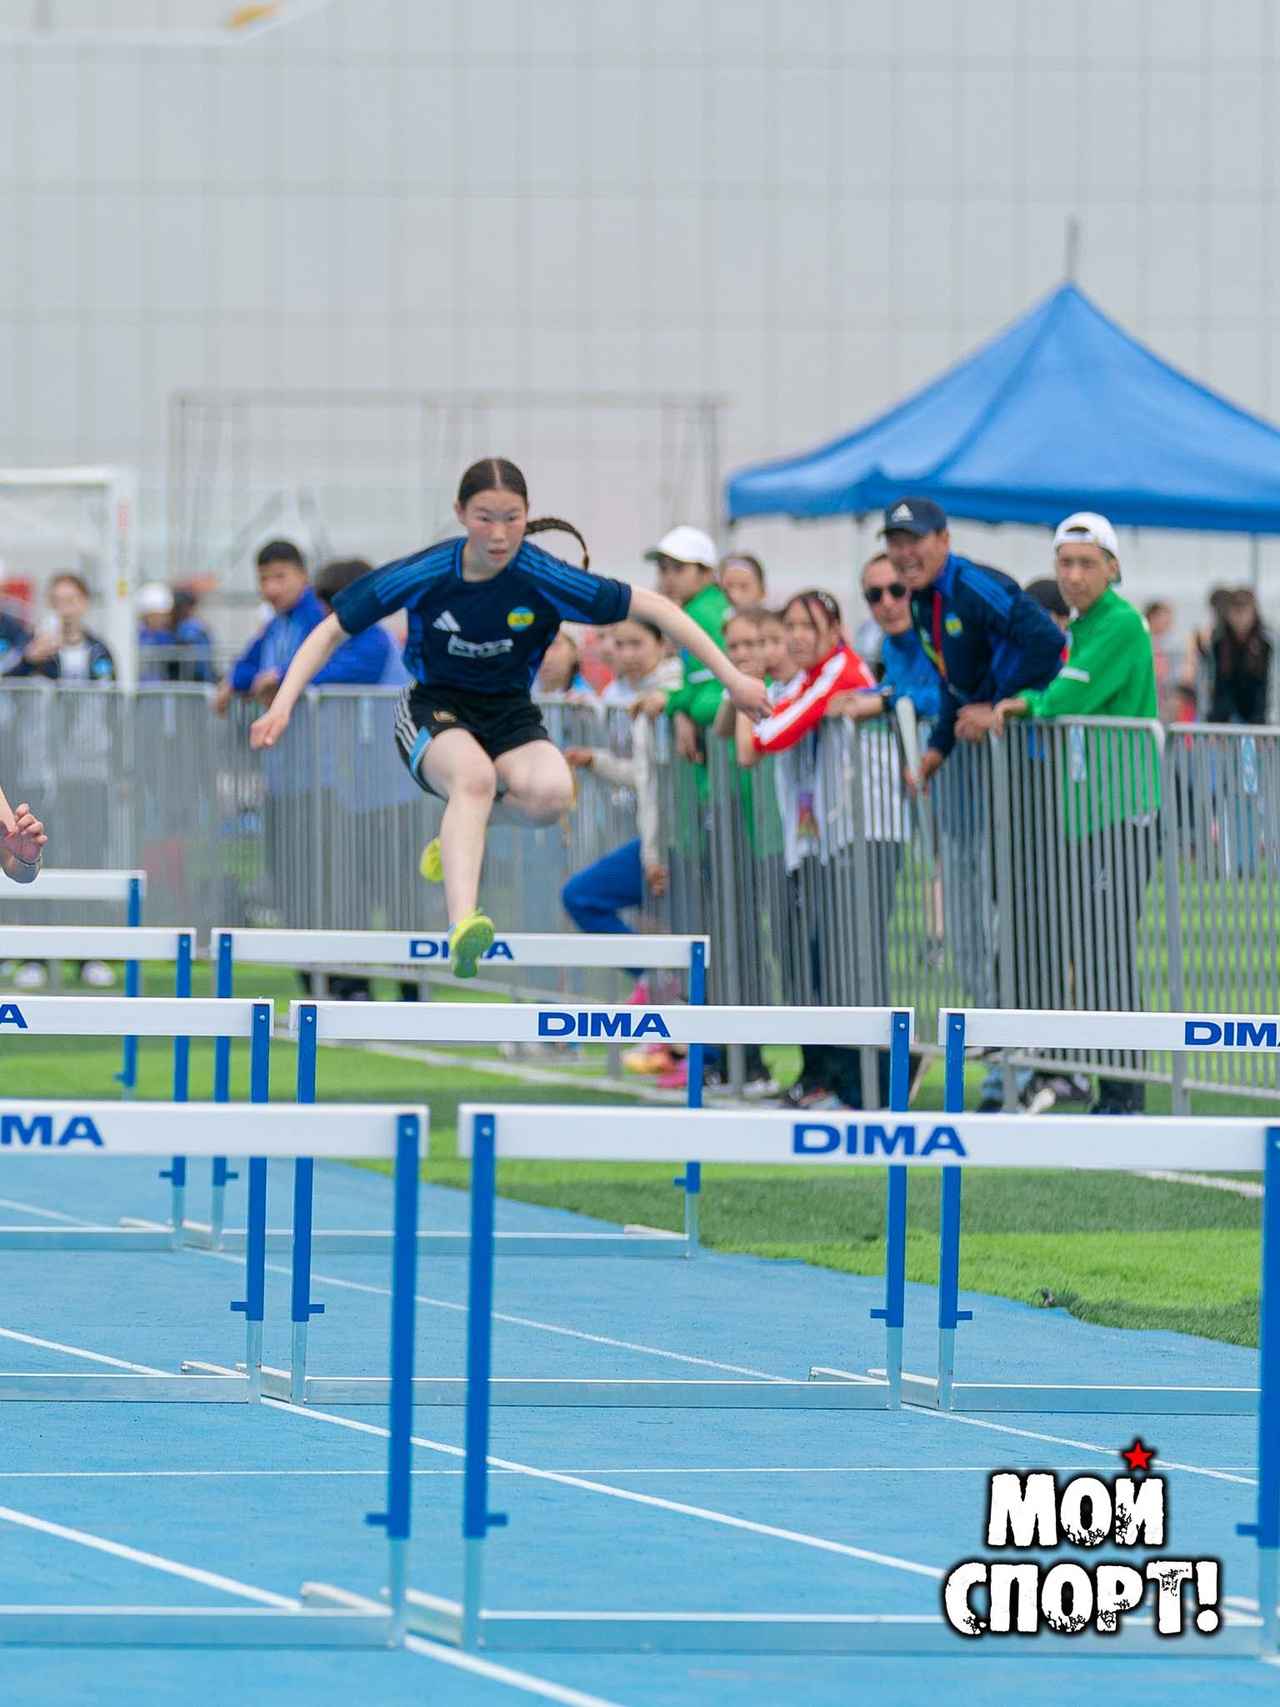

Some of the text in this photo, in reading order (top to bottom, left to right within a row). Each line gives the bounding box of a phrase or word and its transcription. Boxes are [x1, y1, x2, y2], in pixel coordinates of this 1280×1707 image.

[409, 940, 514, 960] DIA
[538, 1012, 671, 1038] DIMA
[1184, 1021, 1280, 1047] DIM
[792, 1123, 967, 1158] DIMA
